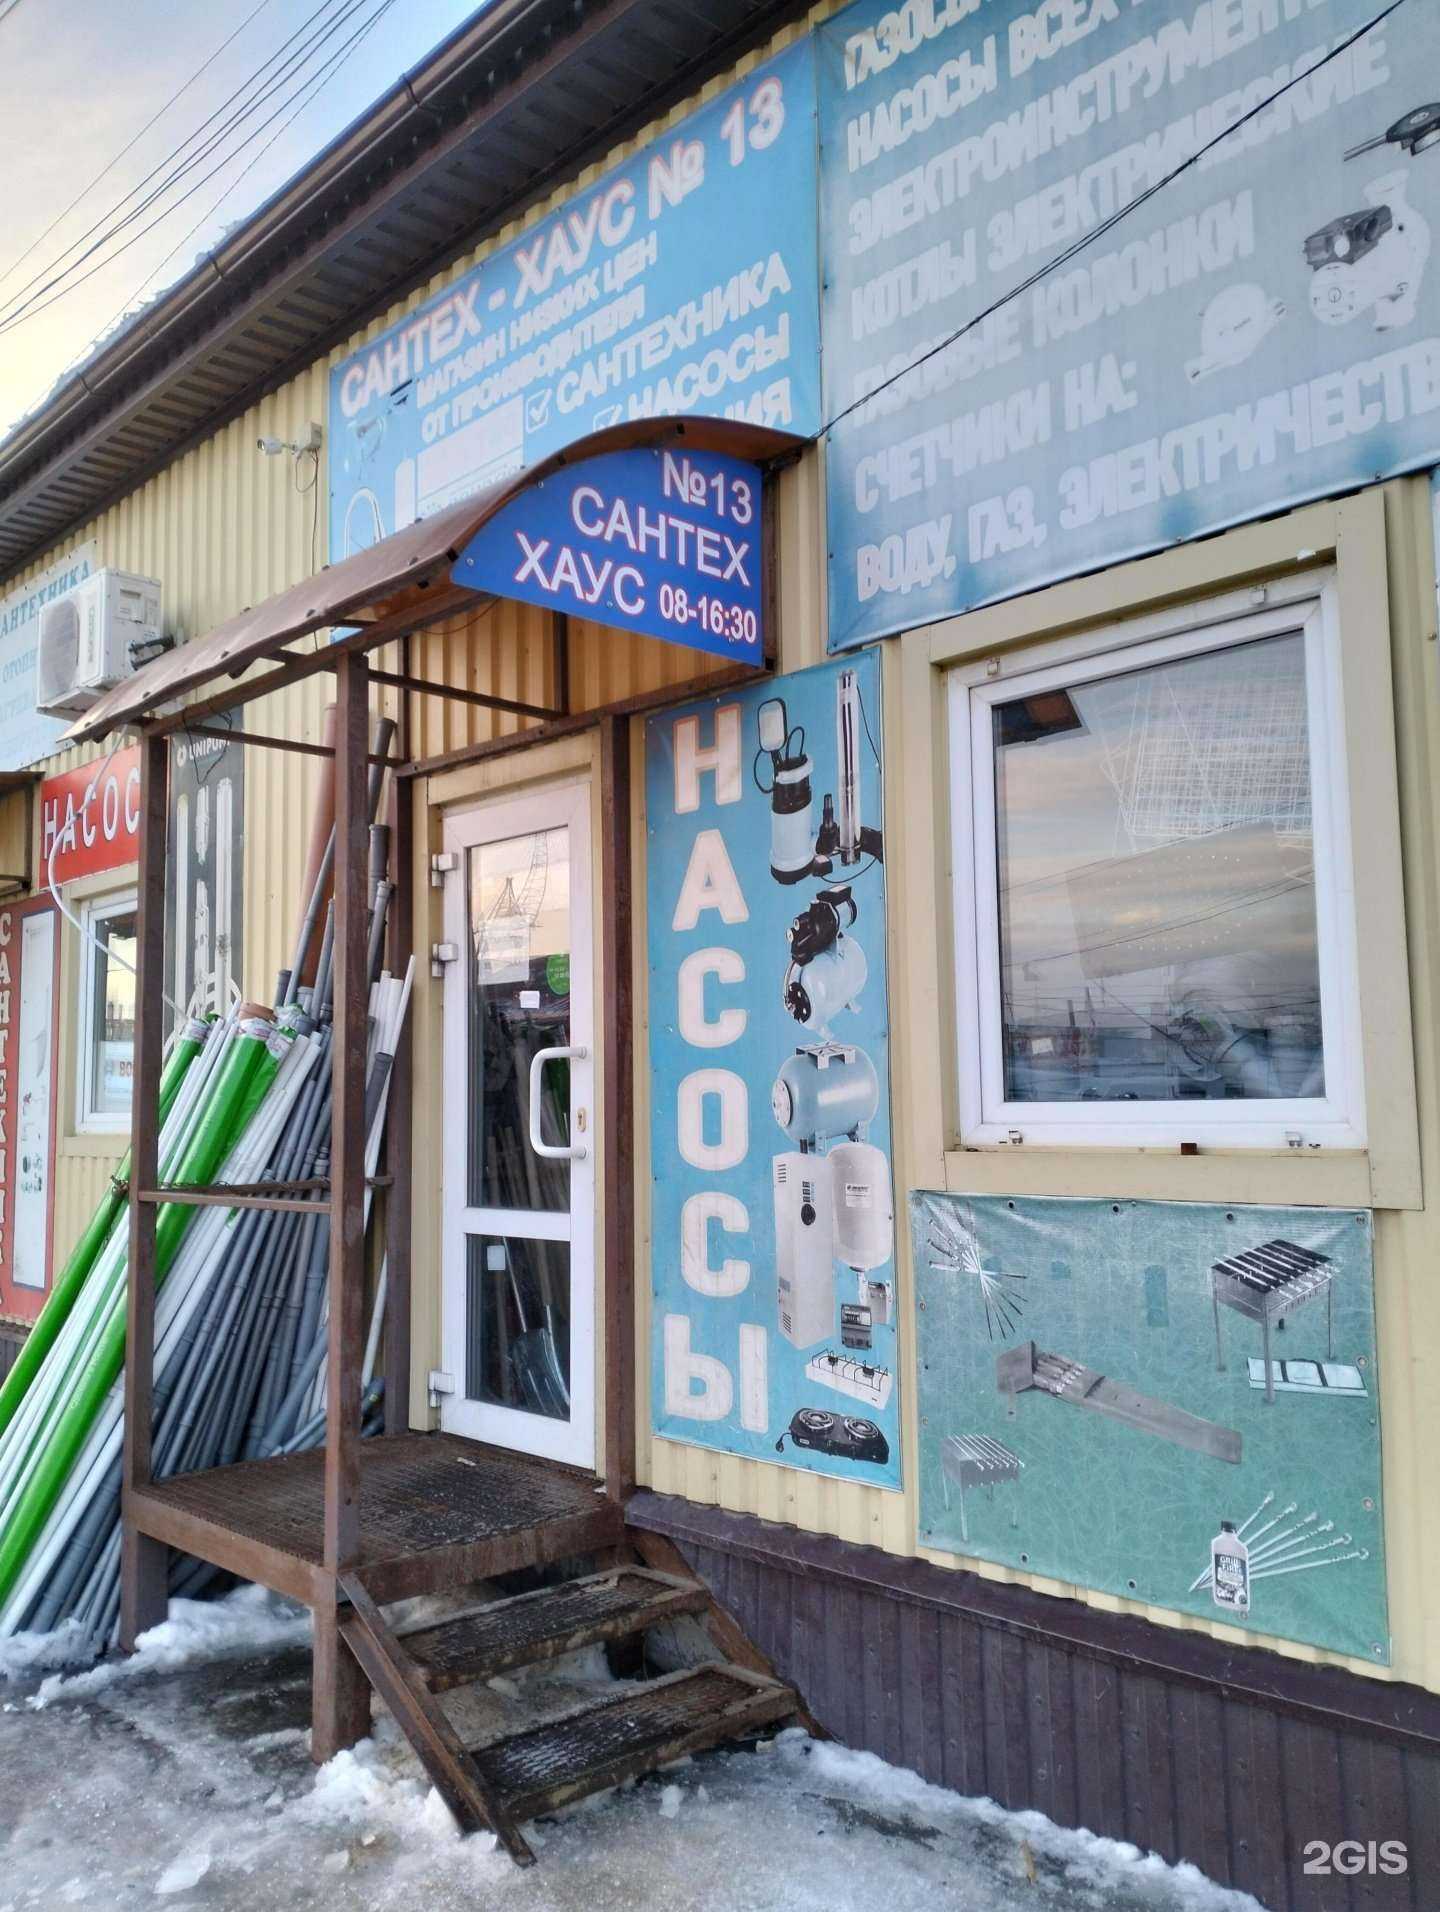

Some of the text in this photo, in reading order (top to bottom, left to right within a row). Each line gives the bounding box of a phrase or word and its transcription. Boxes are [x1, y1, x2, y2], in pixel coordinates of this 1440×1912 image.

[847, 34, 998, 171] НАСОСЫ
[340, 281, 482, 417] САНТЕХ
[513, 177, 636, 309] ХАУС
[648, 140, 705, 220] №
[720, 76, 786, 167] 13
[852, 20, 1391, 342] КОТЛЫ ЭЛЕКТРИЧЕСКИЕ
[416, 230, 657, 408] МАГАЗИН НИЗКИХ ЦЕН
[556, 251, 791, 414] САНТЕХНИКА
[1033, 188, 1254, 348] КОЛОНКИ
[421, 403, 450, 442] ОТ
[627, 312, 790, 420] НАСОСЫ
[855, 353, 1138, 513] СЧЕТЧИКИ НА:
[572, 486, 750, 586] САНТЕХ
[663, 451, 752, 524] №13
[857, 514, 956, 602] ВОДУ,
[968, 485, 1047, 563] ГАЗ,
[0, 560, 90, 638] АНТЕХНИКА
[514, 532, 757, 644] ХАУС 08-16:30
[664, 702, 769, 1434] НАСОСЫ
